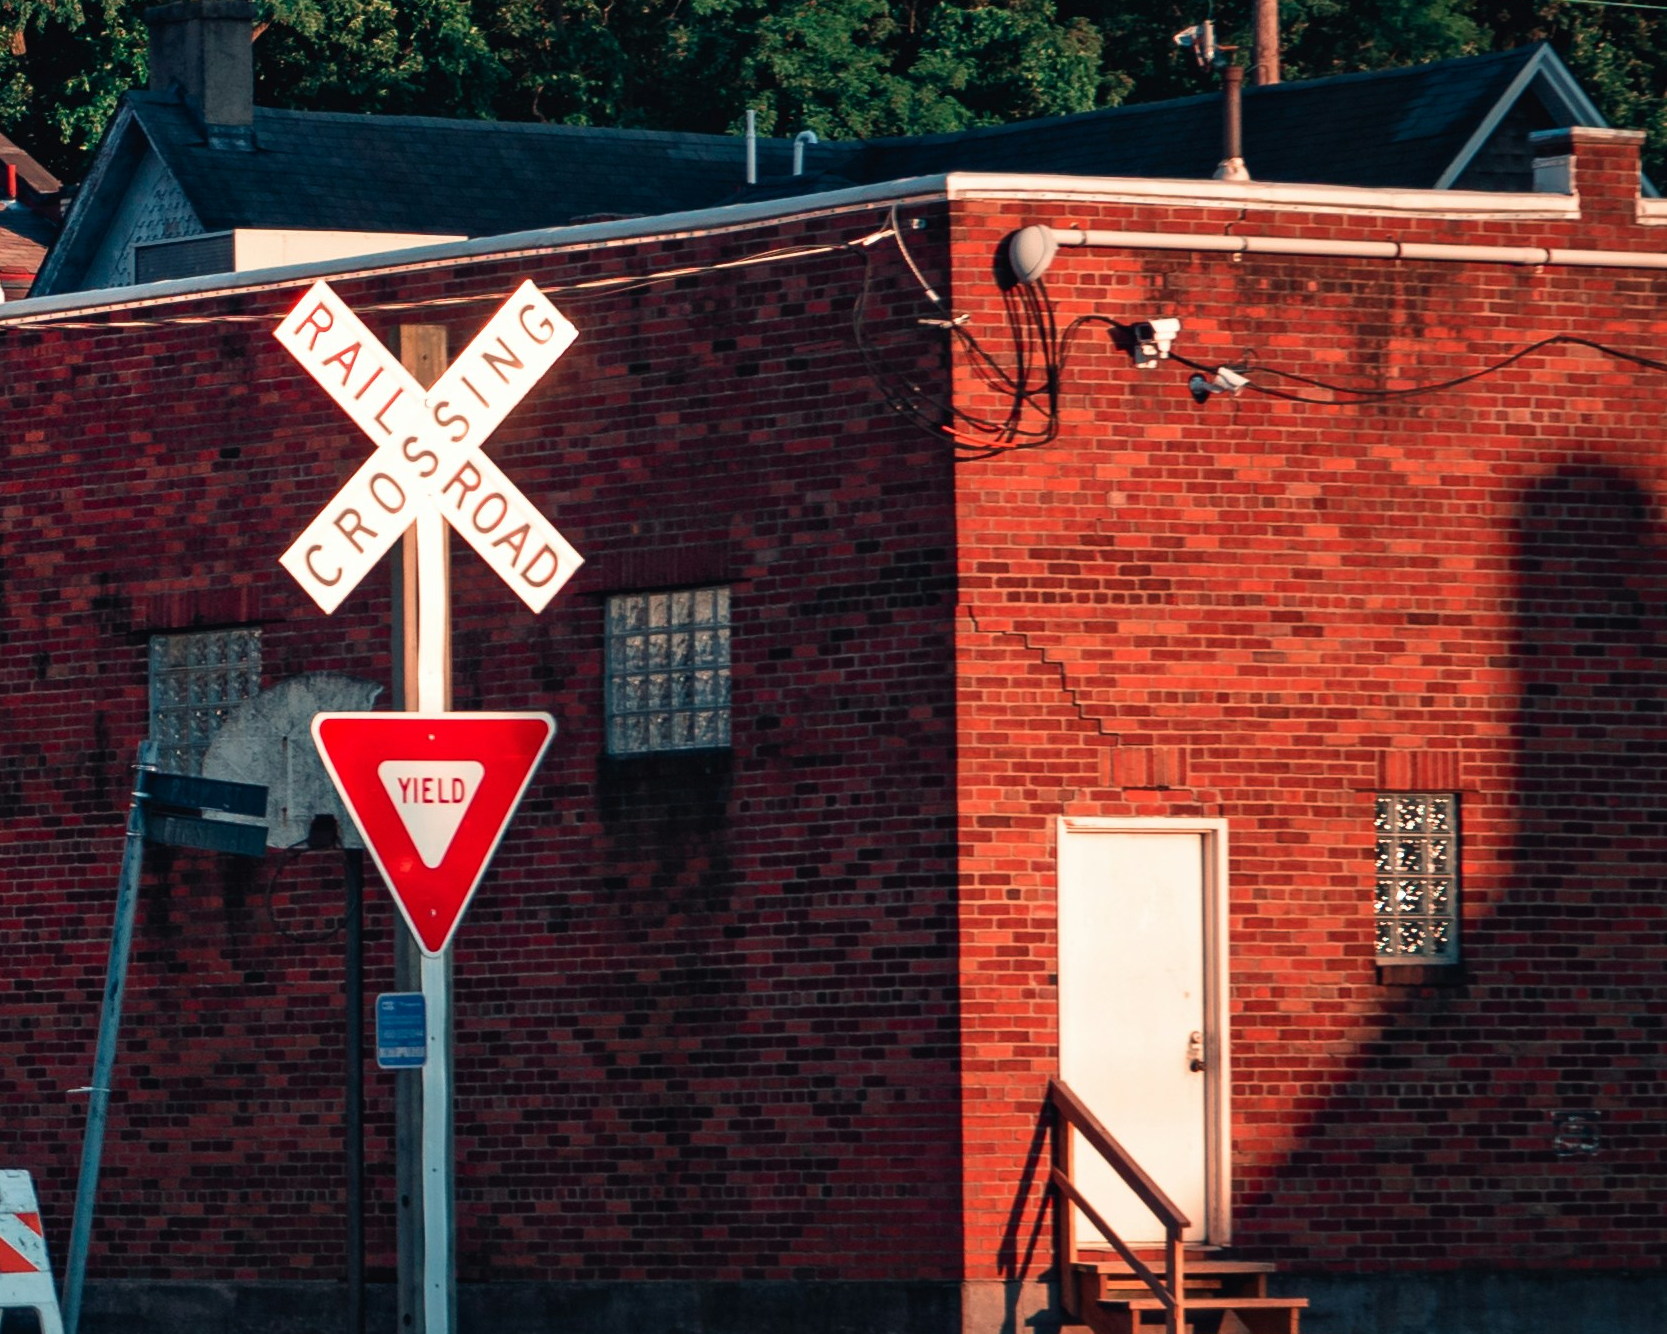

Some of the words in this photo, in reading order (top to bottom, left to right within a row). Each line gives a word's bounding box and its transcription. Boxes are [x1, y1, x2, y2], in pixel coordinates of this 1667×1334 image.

[294, 302, 404, 435] RAIL
[305, 304, 555, 587] CROSSING
[441, 460, 558, 588] ROAD
[397, 777, 465, 804] YIELD
